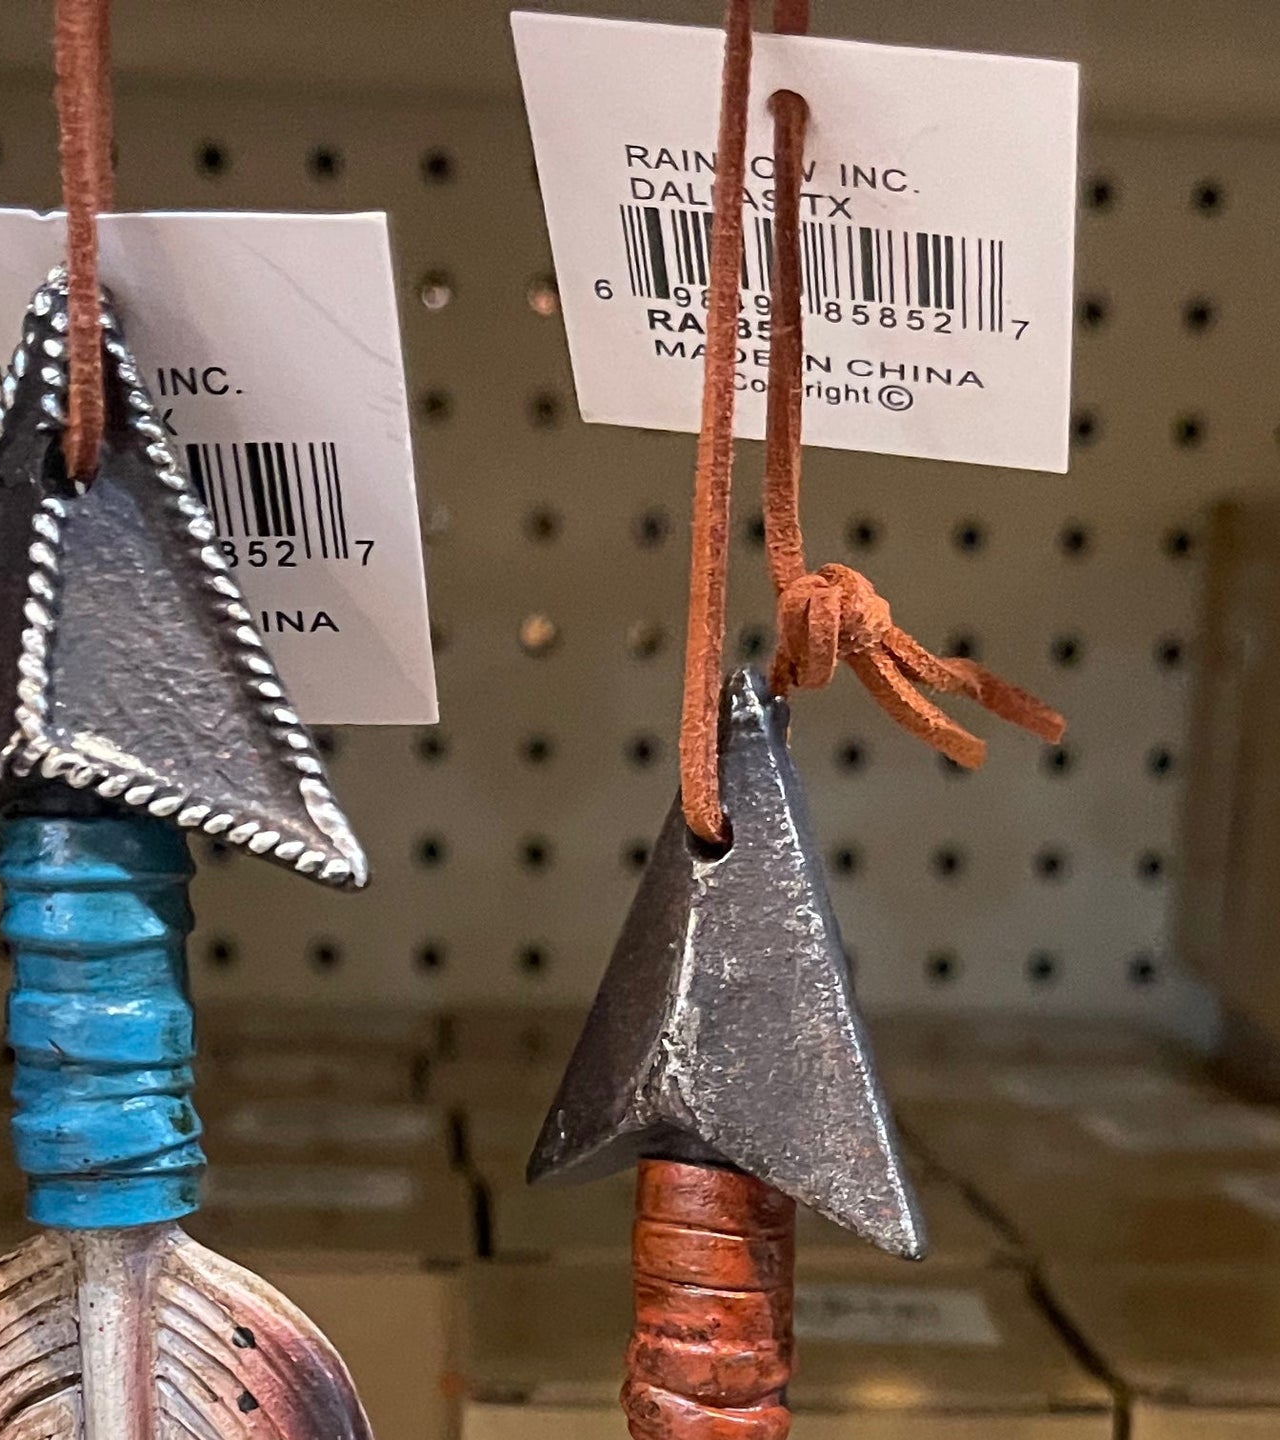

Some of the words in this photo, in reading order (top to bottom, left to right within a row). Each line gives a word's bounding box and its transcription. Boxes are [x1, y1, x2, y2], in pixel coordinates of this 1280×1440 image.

[625, 144, 816, 183] RAINO
[841, 163, 919, 194] INC.
[630, 177, 775, 212] DALAS
[801, 193, 852, 220] TX
[594, 279, 613, 299] 6
[824, 302, 952, 334] 85852
[1011, 320, 1030, 340] 7
[647, 309, 771, 342] RA85
[158, 366, 243, 396] INC.
[847, 359, 985, 388] CHINA
[221, 540, 297, 568] 852
[355, 540, 375, 566] 7
[261, 611, 340, 632] INA
